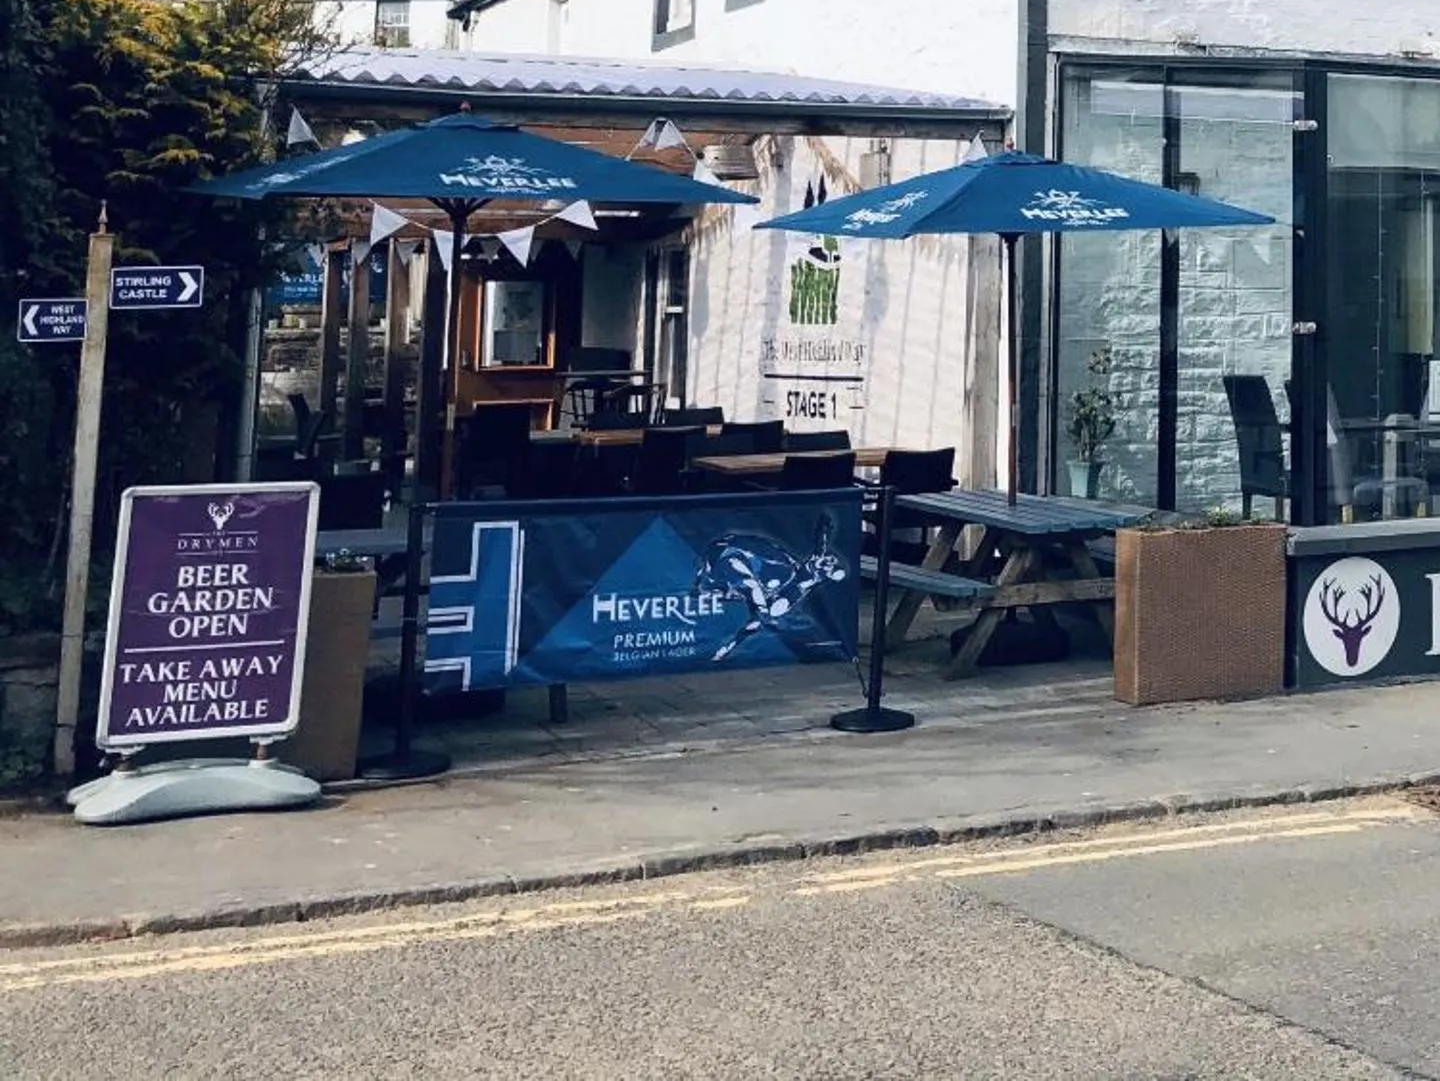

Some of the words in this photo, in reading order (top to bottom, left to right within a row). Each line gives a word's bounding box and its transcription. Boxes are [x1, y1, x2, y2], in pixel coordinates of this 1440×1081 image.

[440, 173, 577, 189] HEVERLEE
[1020, 207, 1130, 220] HEVERLEE
[116, 276, 172, 287] STIRLING
[119, 289, 168, 299] CASTLE
[51, 304, 75, 314] WEST
[40, 315, 85, 325] HIGHLAND
[53, 325, 71, 334] WAY
[786, 390, 826, 419] STAGE
[831, 391, 837, 420] 1
[178, 536, 258, 550] DRYMEN
[178, 563, 249, 588] BEER
[148, 587, 274, 613] GARDEN
[593, 592, 724, 625] HEVERLEE
[168, 614, 249, 638] OPEN
[614, 630, 696, 649] PREMIUM
[119, 660, 191, 683] TAKE
[199, 655, 283, 678] AWAY
[164, 679, 237, 703] MENU
[126, 698, 269, 727] AVAILABLE
